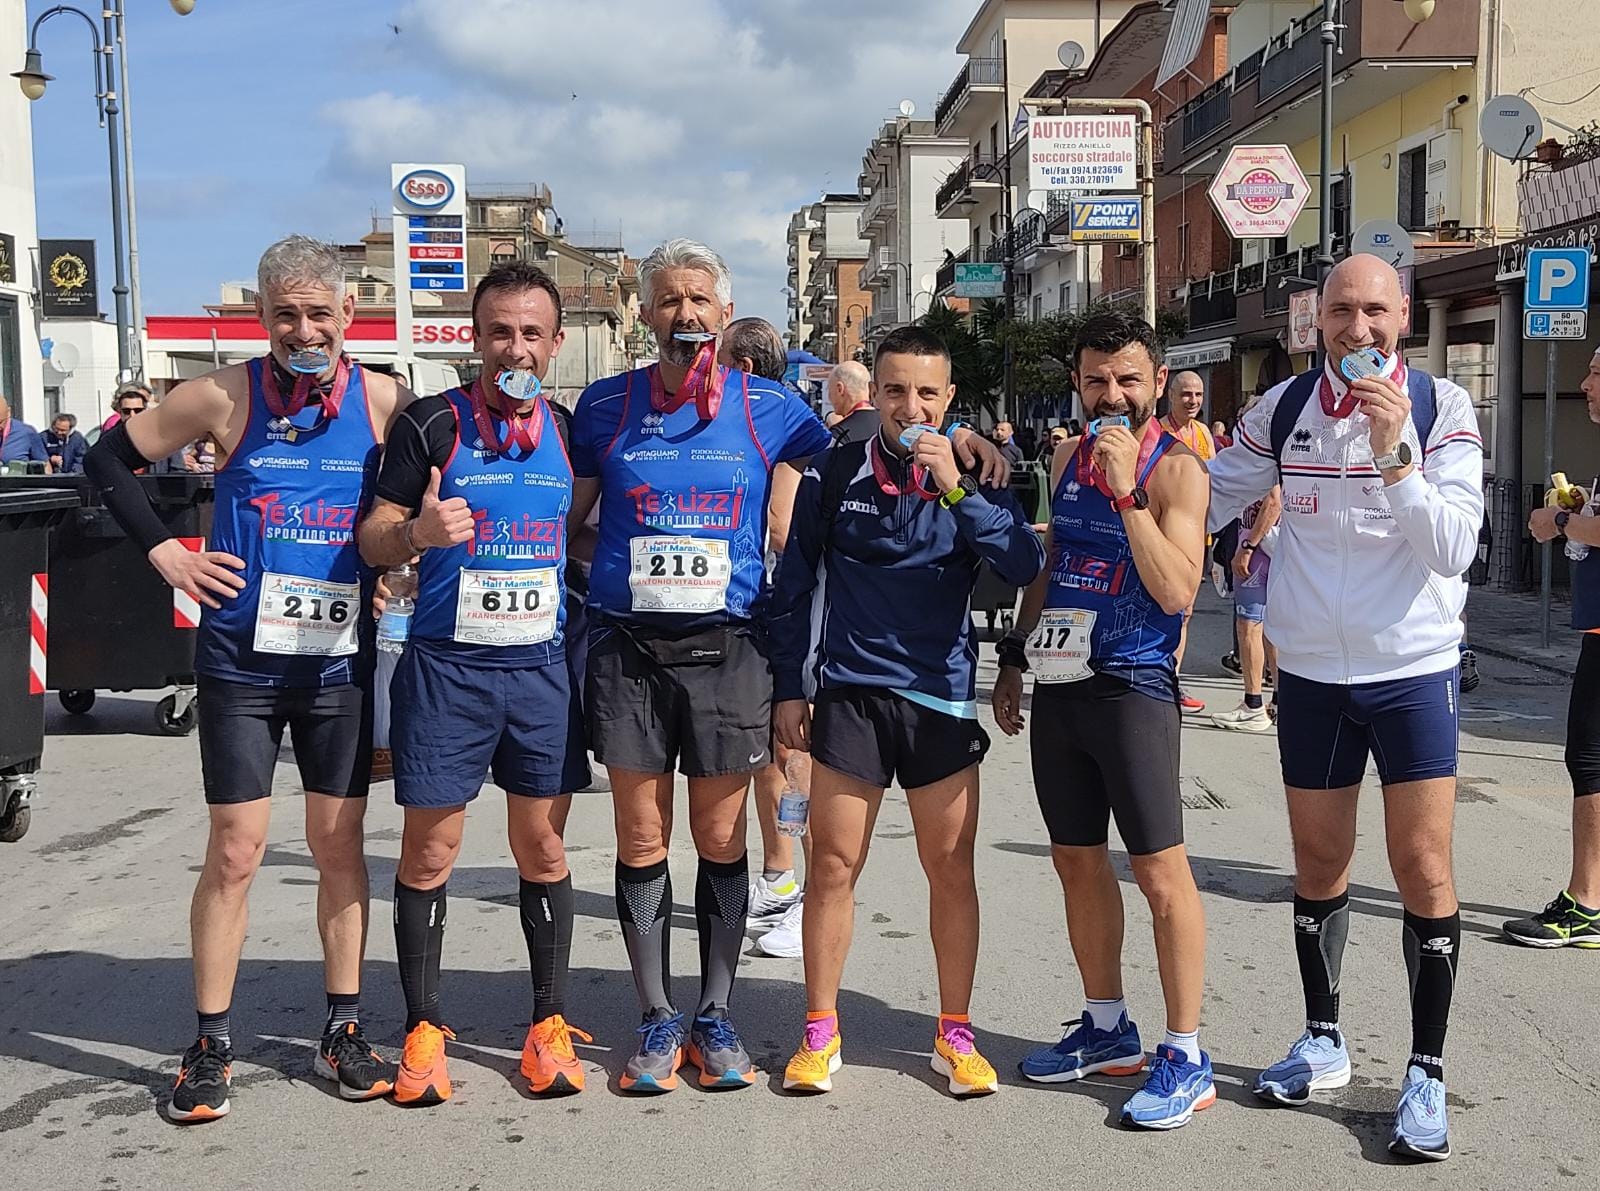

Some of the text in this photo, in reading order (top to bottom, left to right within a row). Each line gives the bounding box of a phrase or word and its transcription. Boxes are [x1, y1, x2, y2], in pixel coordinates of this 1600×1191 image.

[1032, 120, 1133, 139] AUTOFFICINA
[1032, 150, 1133, 163] soccorso stradale
[1041, 166, 1070, 175] Tel/Fax
[1050, 175, 1114, 185] Cell. 330.270791
[408, 179, 446, 196] Esso
[1236, 185, 1285, 195] DA PEPPONE
[1092, 204, 1136, 215] POINT
[1087, 216, 1128, 226] SERVICE
[429, 279, 445, 288] Bar
[1539, 259, 1577, 301] P
[412, 326, 474, 344] ESSO
[1290, 444, 1310, 452] errea
[262, 457, 310, 466] VITAGLIANO
[469, 473, 514, 481] VITAGLIANO
[645, 515, 731, 526] SPORTING CLUB
[266, 527, 326, 542] SPORTING
[476, 543, 557, 556] SPORTING CLUB
[649, 544, 668, 553] Half
[650, 554, 709, 577] 218
[482, 579, 544, 588] Half Marathon
[674, 578, 722, 586] VITAGLIANO
[284, 584, 354, 598] Half Marathon
[482, 589, 540, 612] 610
[283, 596, 349, 624] 216
[466, 611, 551, 621] FRANCESCO LORUSSO
[262, 617, 323, 630] MICHELANGELO
